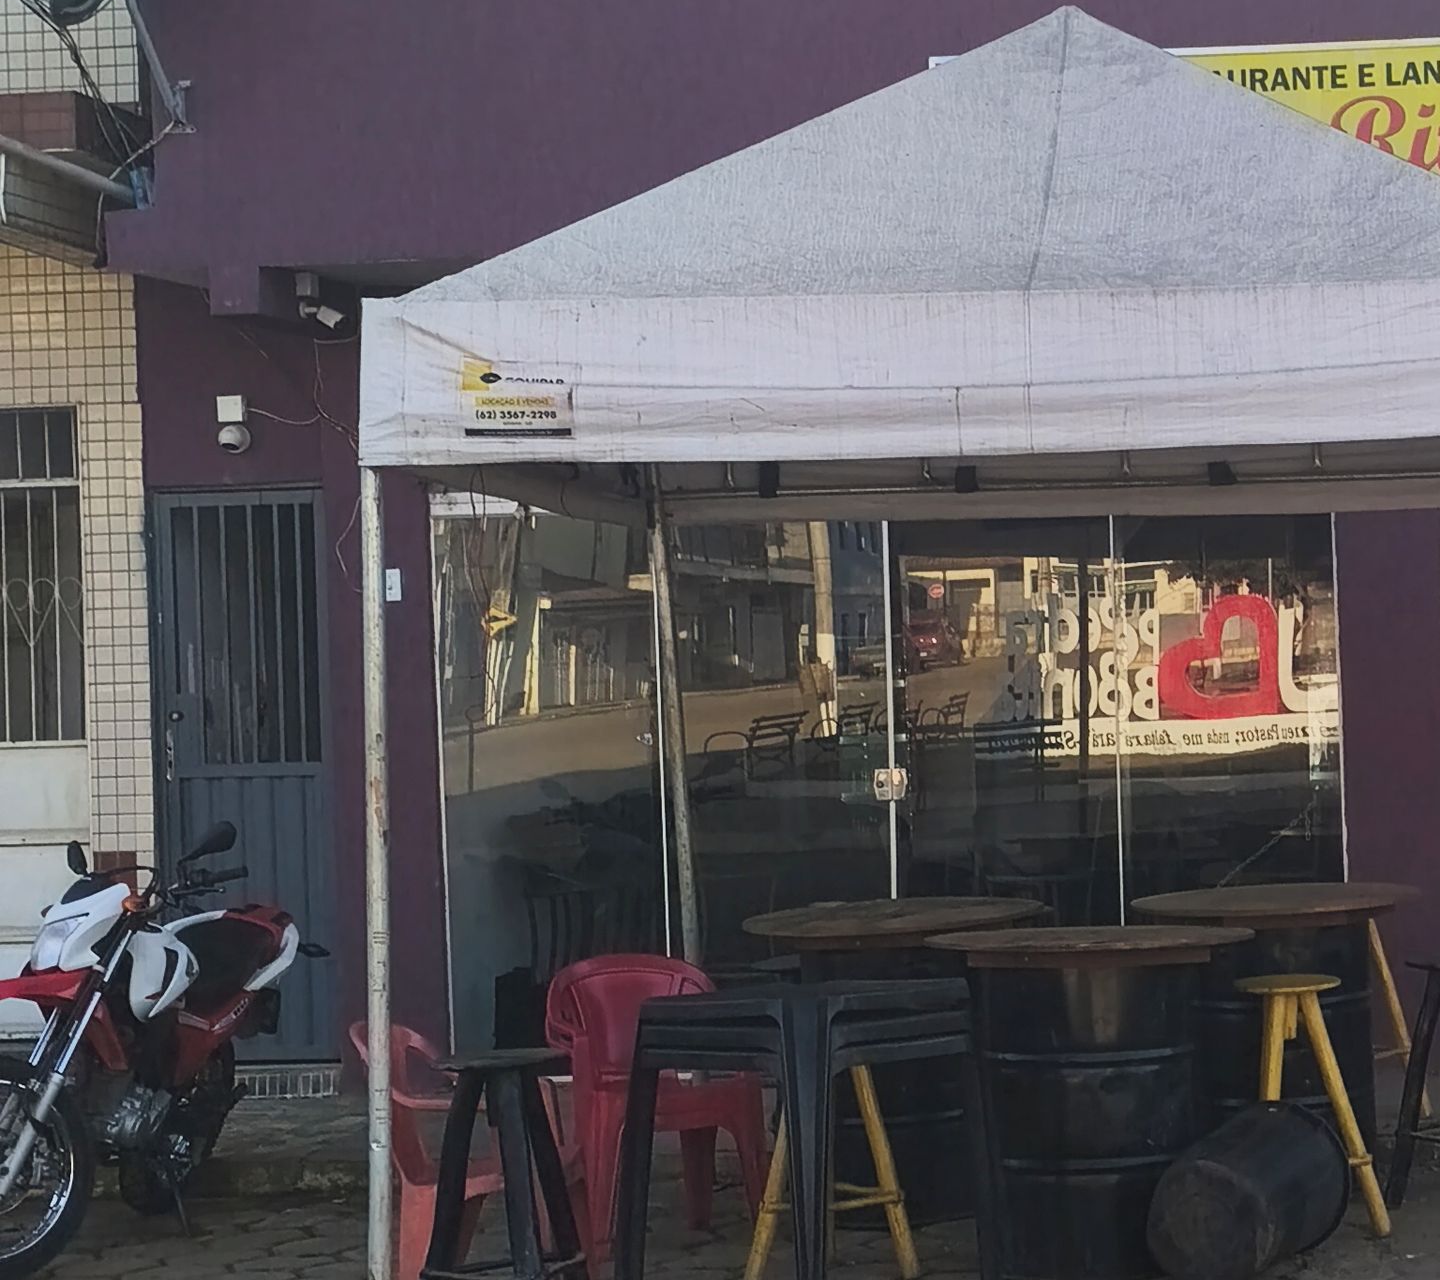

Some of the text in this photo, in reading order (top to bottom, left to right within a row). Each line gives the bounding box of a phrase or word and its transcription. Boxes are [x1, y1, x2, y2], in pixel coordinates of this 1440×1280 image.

[1213, 64, 1348, 93] URANTE
[1358, 63, 1376, 88] E
[475, 409, 497, 420] (62)
